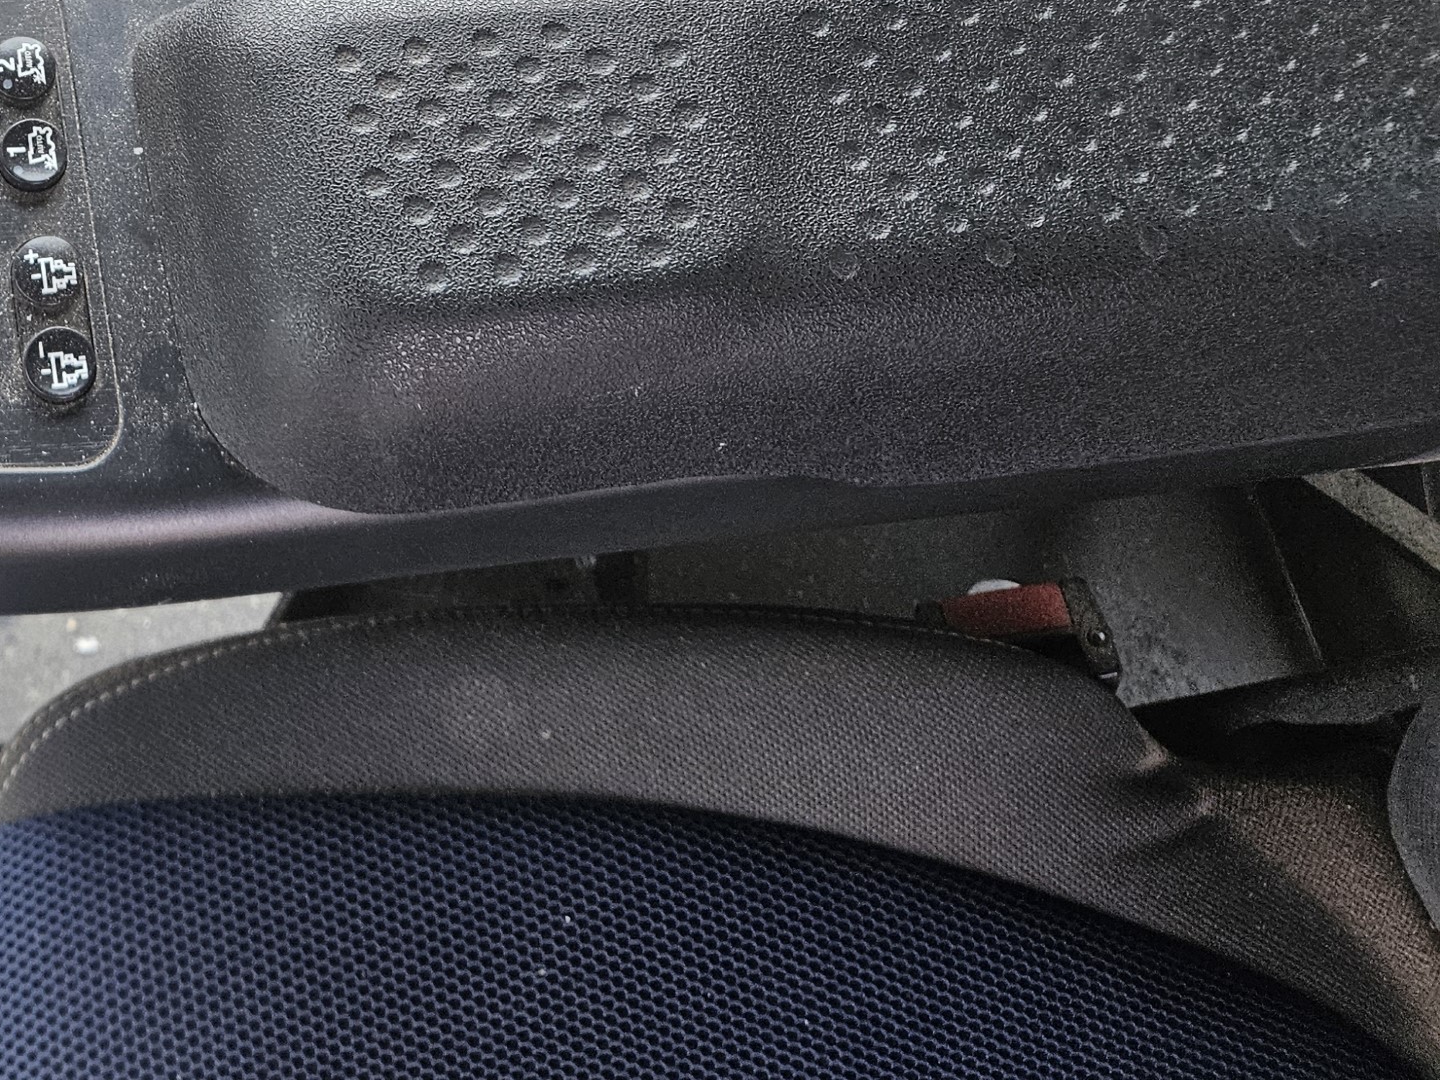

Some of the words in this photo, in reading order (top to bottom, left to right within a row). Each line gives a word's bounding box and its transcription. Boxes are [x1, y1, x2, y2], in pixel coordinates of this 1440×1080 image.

[24, 50, 33, 69] AUTO
[7, 146, 27, 158] 1
[36, 134, 45, 155] AUTO
